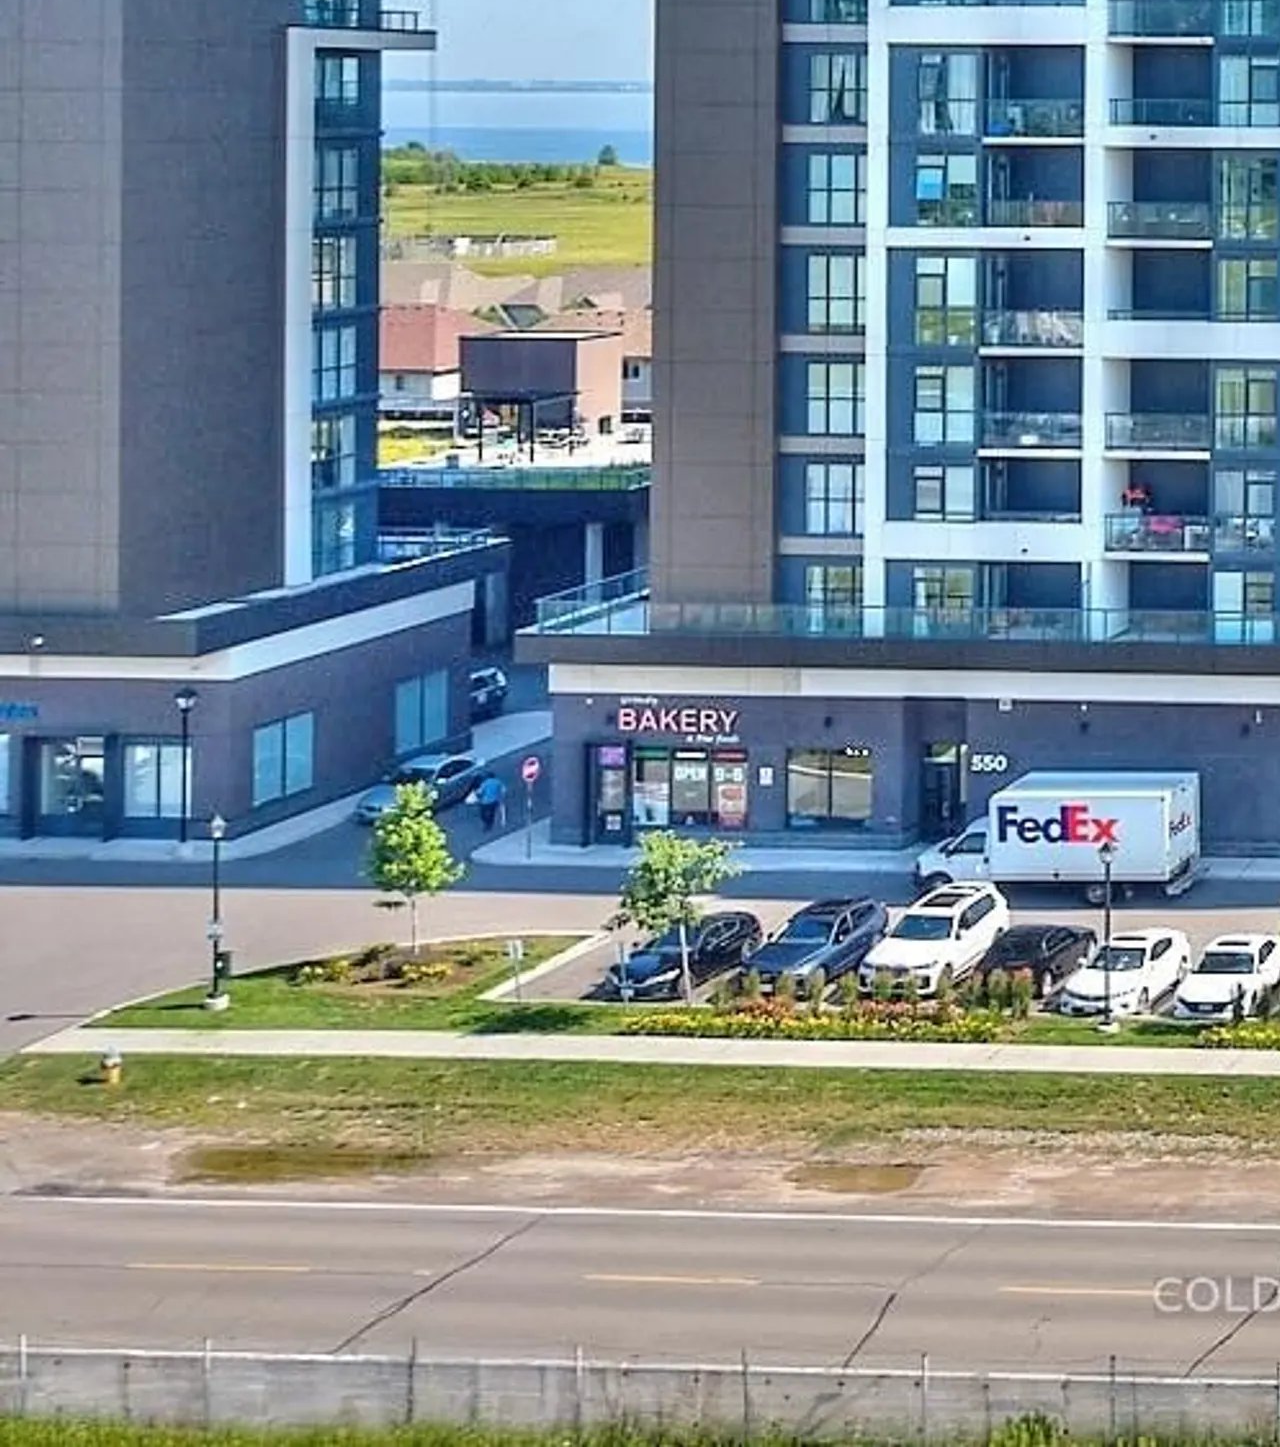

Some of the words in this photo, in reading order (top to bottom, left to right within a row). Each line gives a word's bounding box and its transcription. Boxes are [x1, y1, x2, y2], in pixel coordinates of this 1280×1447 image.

[618, 707, 738, 733] BAKERY
[970, 754, 1008, 772] 550
[997, 805, 1120, 844] FedEx
